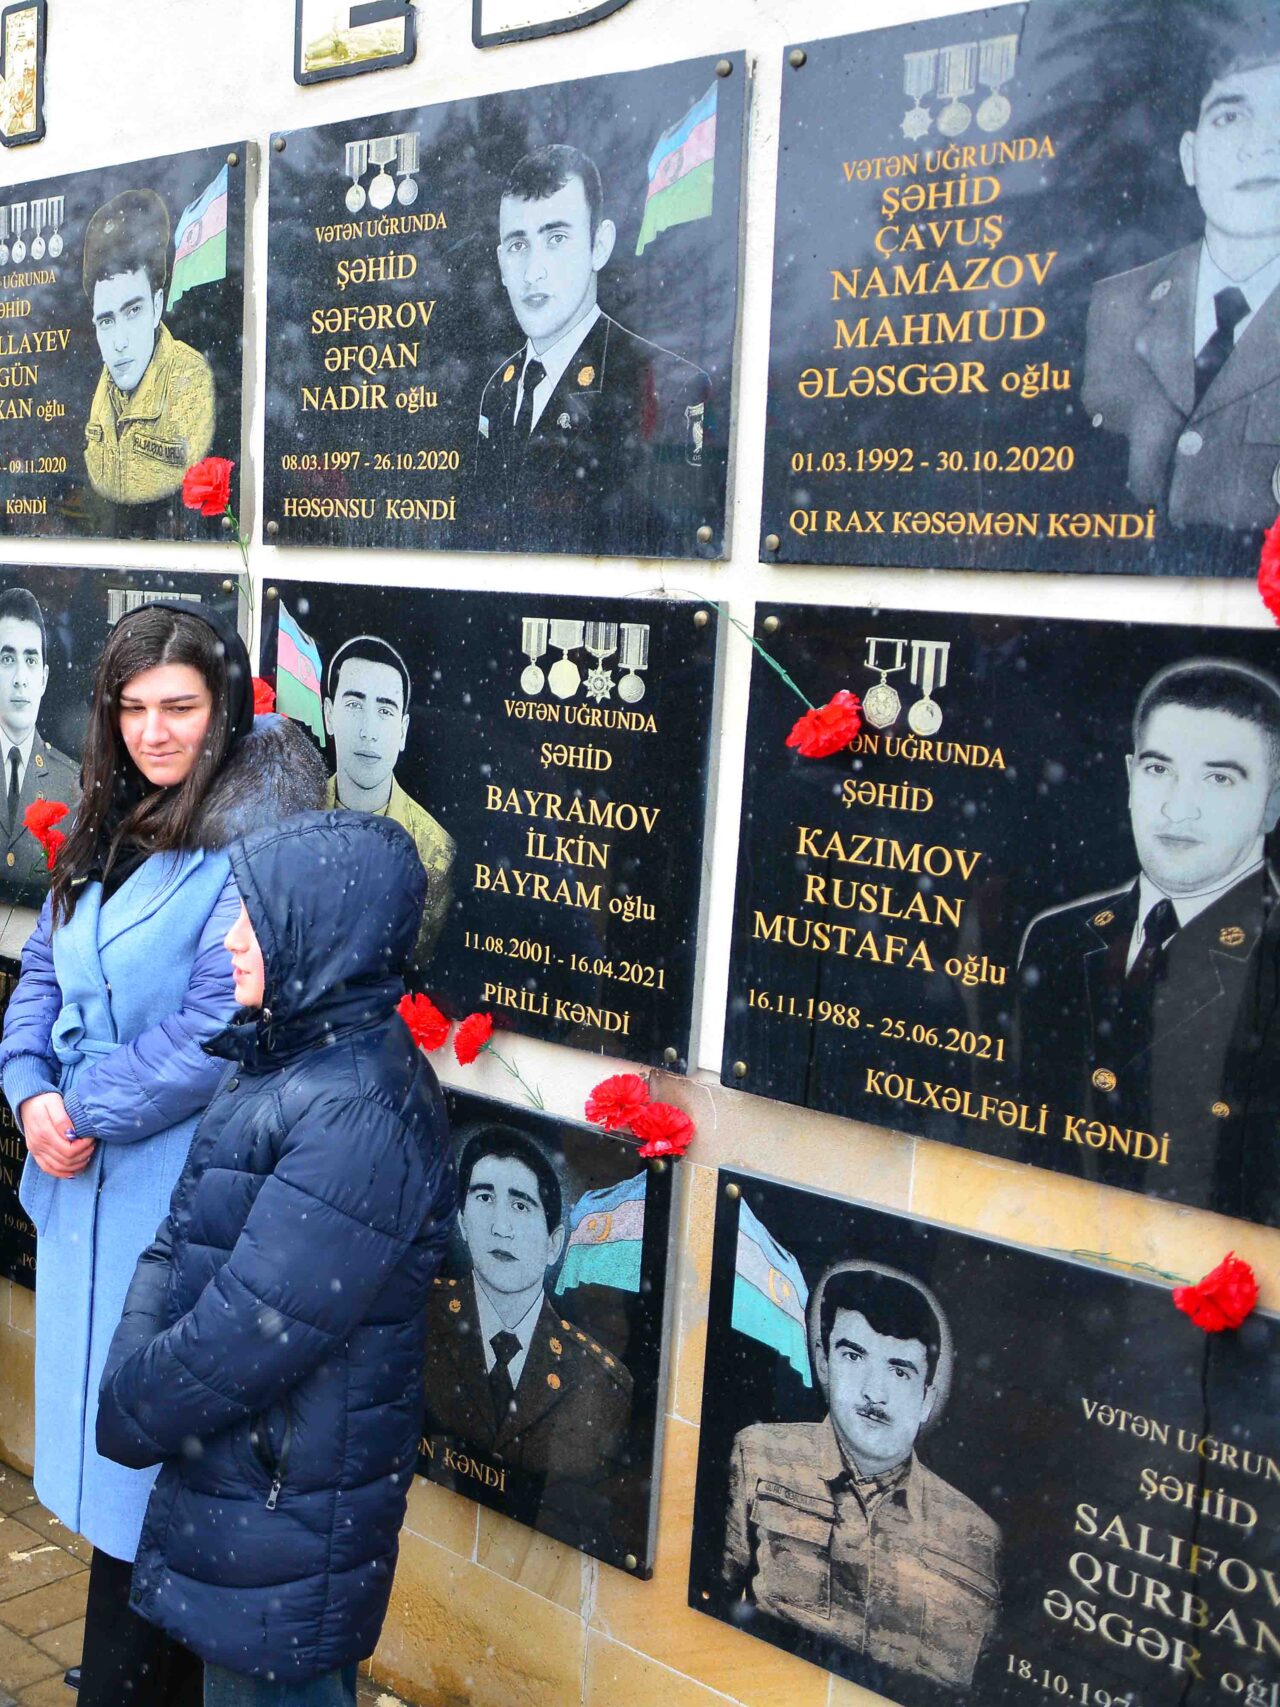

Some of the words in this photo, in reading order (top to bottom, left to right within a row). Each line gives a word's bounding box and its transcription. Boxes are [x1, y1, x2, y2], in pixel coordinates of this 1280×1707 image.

[842, 153, 918, 182] VƏTƏN
[924, 135, 1056, 173] UĞRUNDA
[881, 172, 1001, 220] ŞƏHİD
[315, 221, 363, 243] VƏTƏN
[367, 211, 448, 237] UĞRUNDA
[874, 214, 1004, 260] ÇAVUŞ
[3, 269, 56, 290] UĞRUNDA
[337, 250, 418, 290] ŞƏHİD
[830, 250, 1058, 300] NAMAZOV
[311, 300, 437, 335] SƏFƏROV
[832, 306, 1046, 350] MAHMUD
[324, 342, 420, 375] ƏFQAN
[797, 360, 990, 399] ƏLƏSGƏR
[1001, 362, 1072, 398] oğlu
[36, 399, 65, 422] oğlu
[301, 379, 388, 412] NADİR
[396, 386, 438, 413] oğlu
[9, 456, 67, 474] 09.11.2020
[281, 451, 361, 471] 08.03.1997
[374, 450, 460, 471] 26.10.2020
[791, 446, 915, 473] 01.03.1992
[936, 445, 1075, 473] 30.10.2020
[6, 496, 47, 515] KƏNDİ
[283, 497, 376, 519] HƏSƏNSU
[385, 494, 457, 521] KƏNDİ
[892, 511, 1041, 537] KƏSƏMƏN
[1048, 508, 1158, 540] KƏNDİ
[504, 699, 560, 724] VƏTƏN
[564, 703, 658, 733] UĞRUNDA
[540, 742, 612, 772] ŞƏHİD
[885, 733, 1007, 770] UĞRUNDA
[485, 784, 661, 834] BAYRAMOV
[842, 779, 935, 814] ŞƏHİD
[525, 826, 610, 870] İLKİN
[796, 826, 982, 881] KAZIMOV
[474, 863, 602, 912] BAYRAM
[609, 894, 656, 922] oğlu
[804, 874, 965, 929] RUSLAN
[463, 931, 552, 965] 11.08.2001
[570, 952, 666, 990] 16.04.2021
[752, 911, 936, 973] MUSTAFA
[945, 953, 1007, 988] oğlu
[484, 981, 549, 1016] PİRİLİ
[555, 999, 632, 1036] KƏNDİ
[747, 988, 860, 1029] 16.11.1988
[881, 1017, 1006, 1063] 25.06.2021
[864, 1068, 1049, 1136] KOLXƏLFƏLİ
[1062, 1114, 1172, 1166] KƏNDİ
[1081, 1397, 1171, 1445] VƏTƏN
[1177, 1429, 1280, 1485] UĞRUN
[444, 1447, 505, 1492] KƏNDİ
[1139, 1467, 1258, 1528] ŞƏHİD
[1043, 1589, 1205, 1679] ƏSGƏR
[1220, 1673, 1280, 1707] oğl
